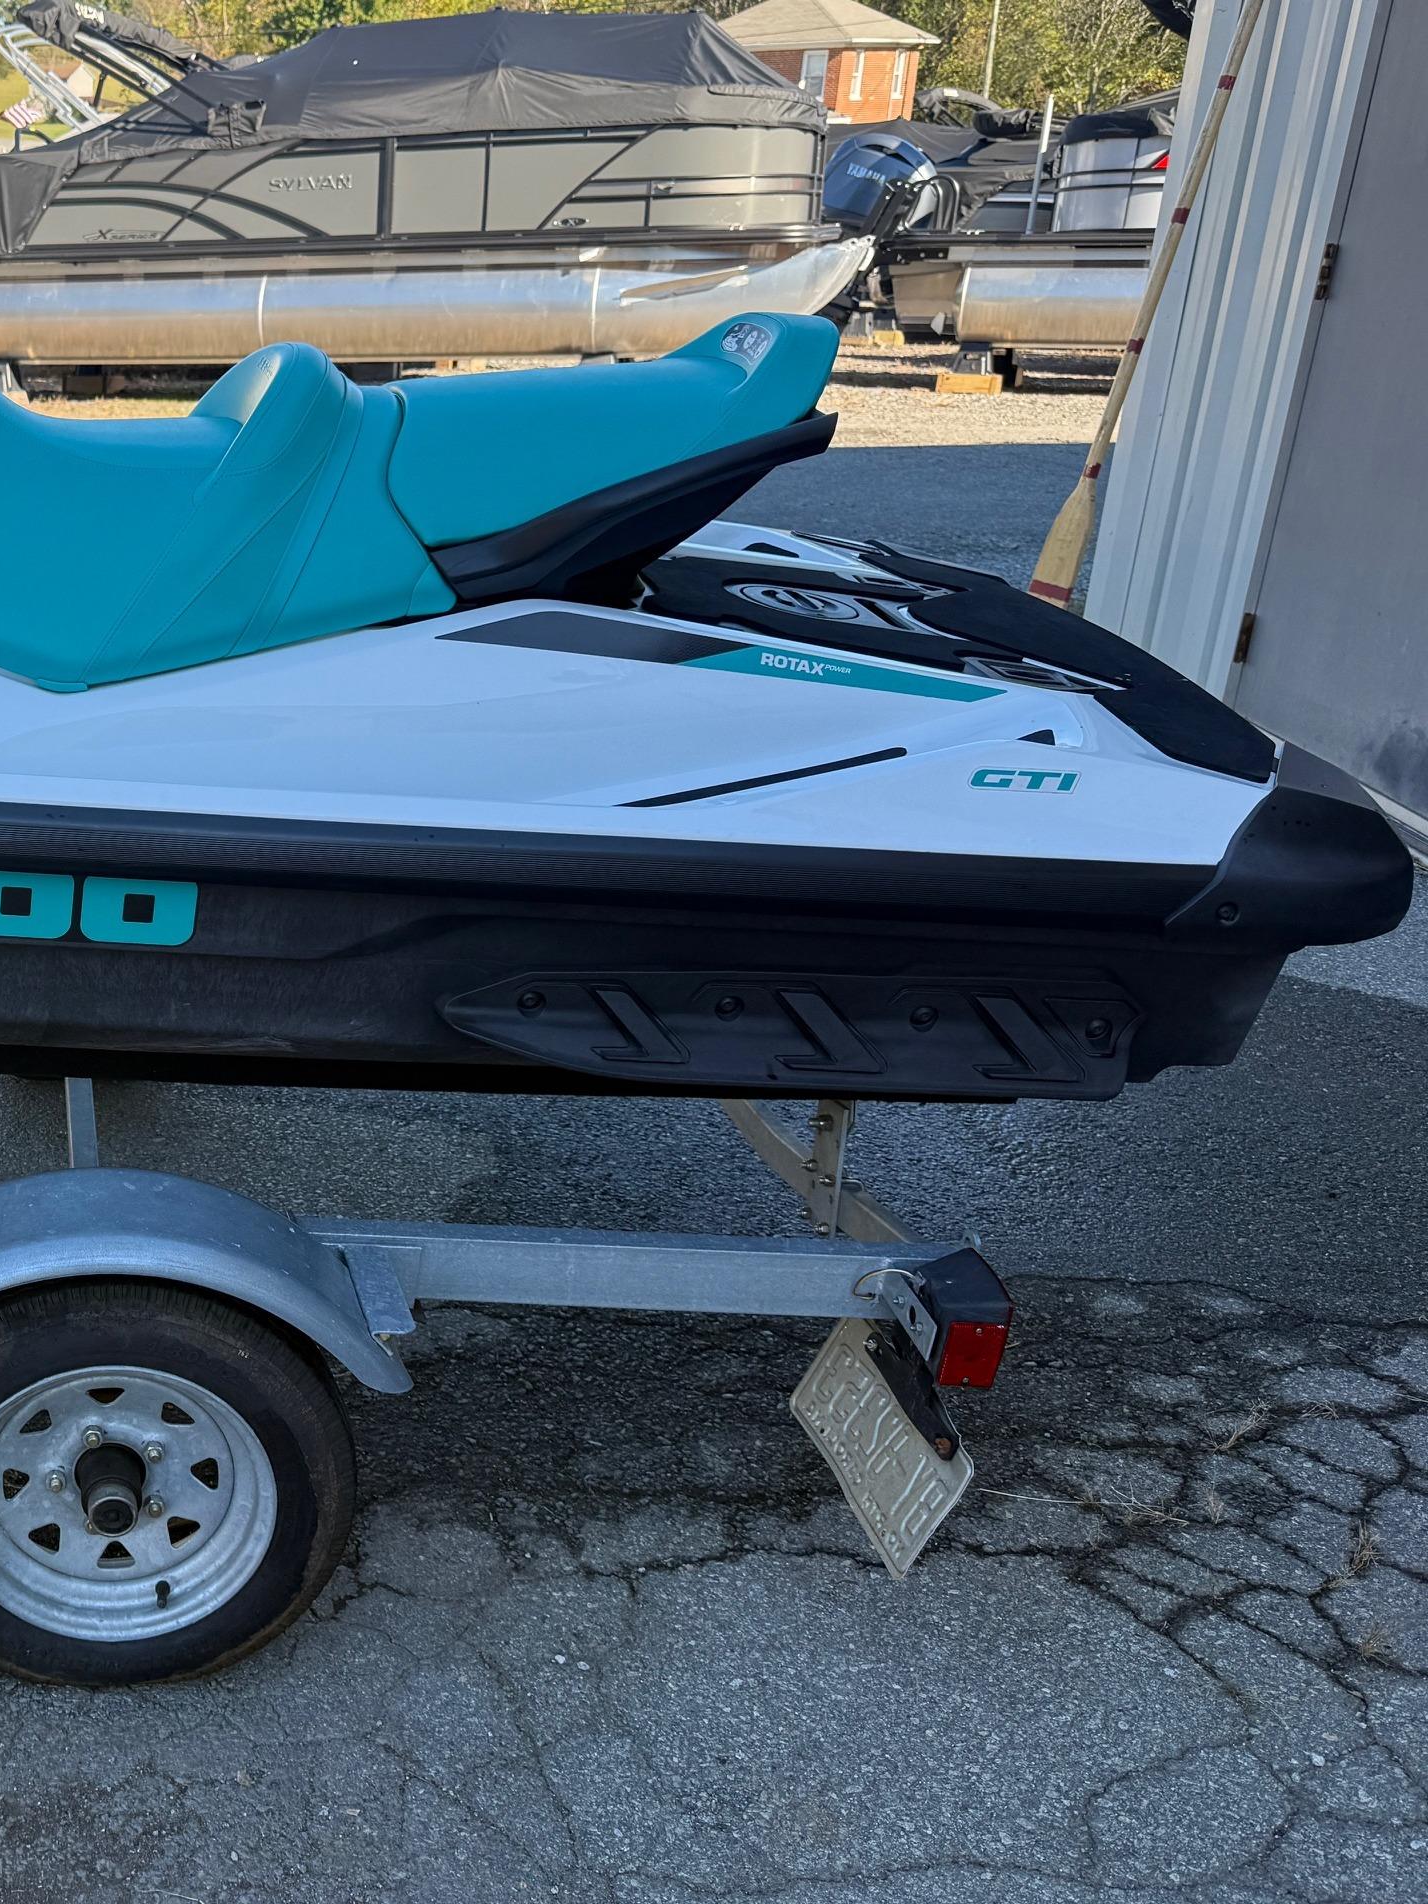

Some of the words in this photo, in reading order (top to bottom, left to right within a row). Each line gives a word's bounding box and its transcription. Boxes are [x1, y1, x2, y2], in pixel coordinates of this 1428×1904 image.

[268, 175, 353, 193] SYLVAN
[760, 652, 826, 676] ROTAX
[824, 663, 852, 674] POWER
[970, 768, 1079, 792] GTI
